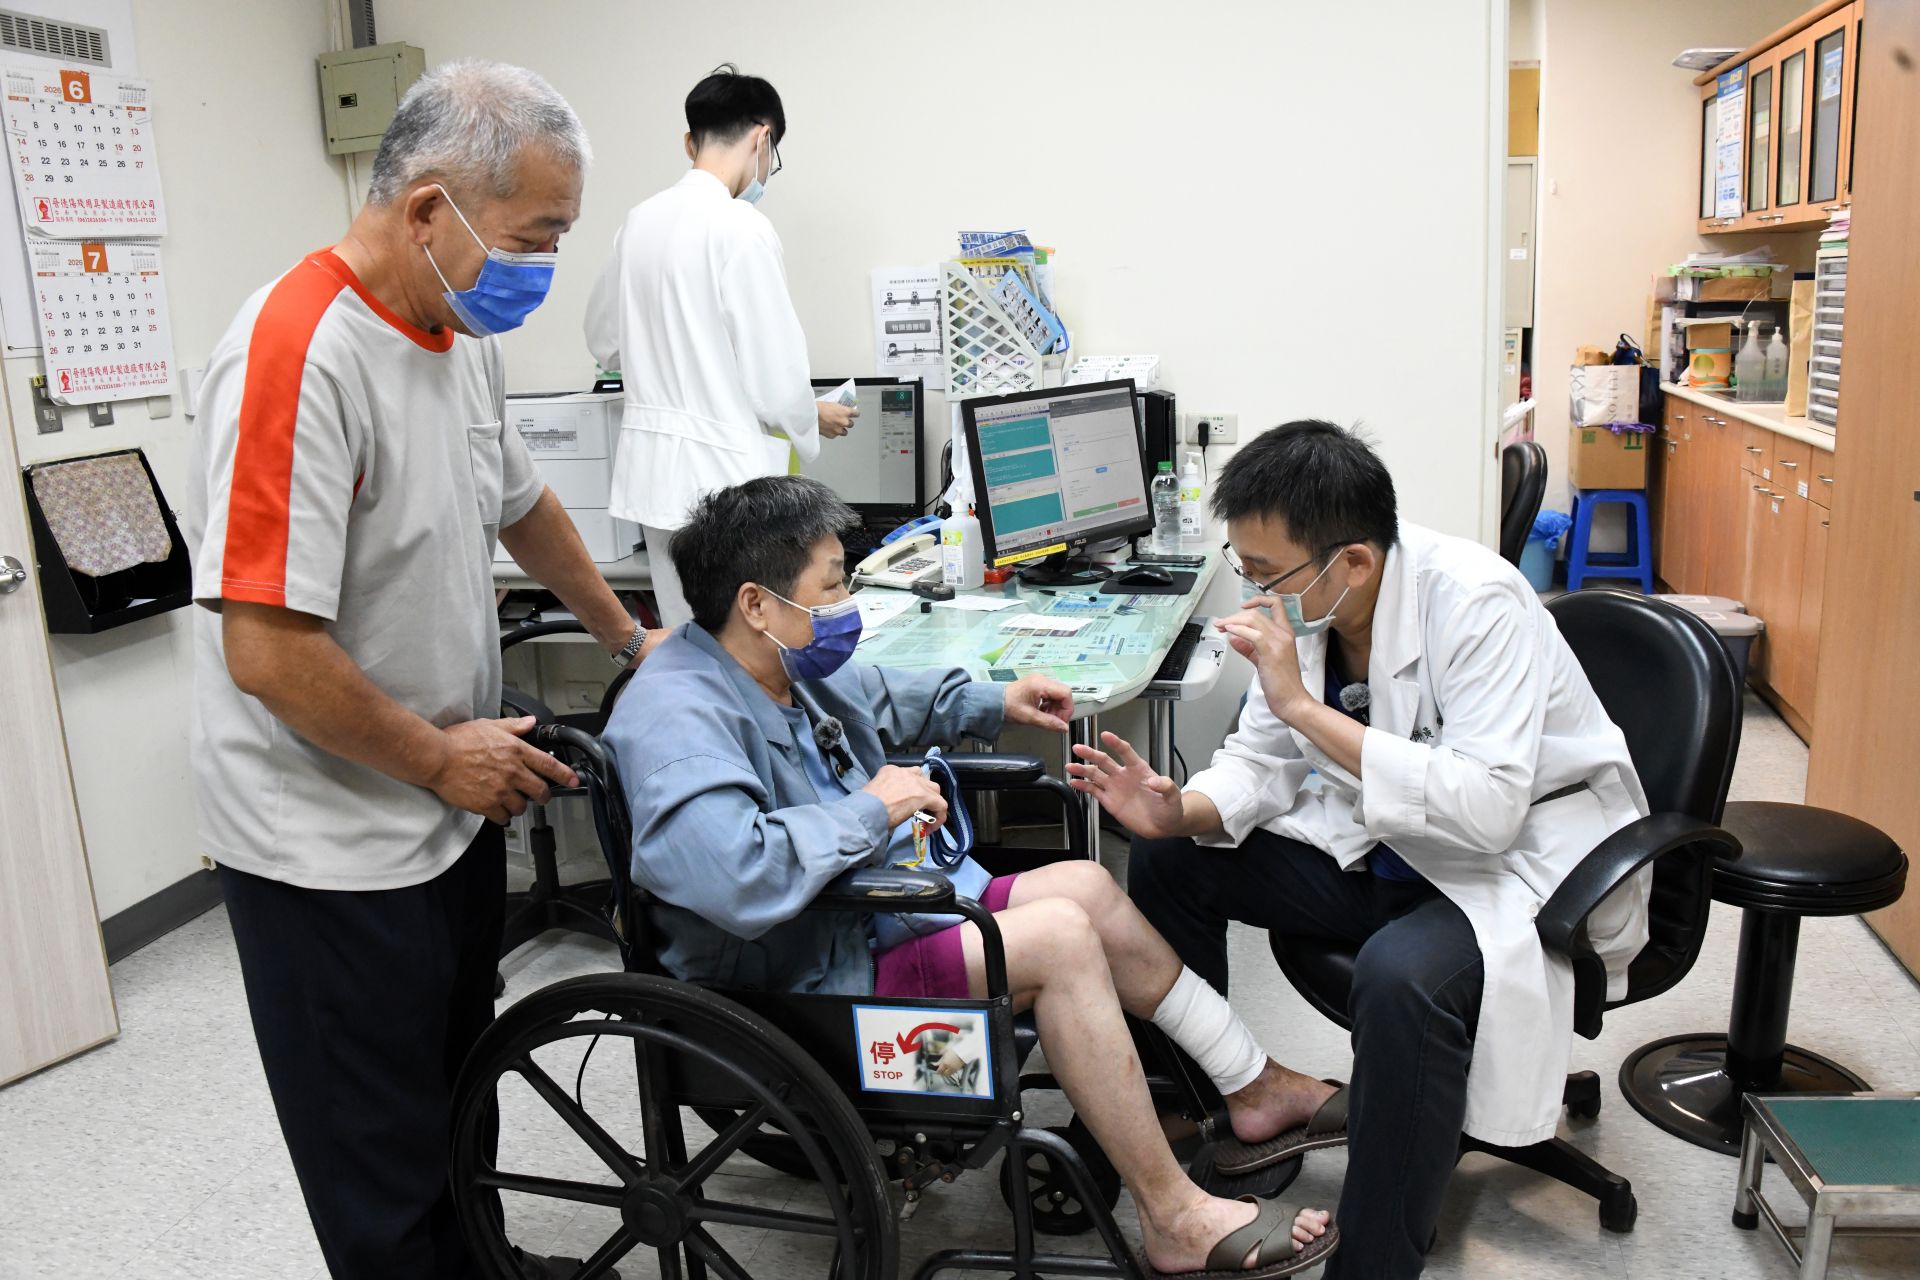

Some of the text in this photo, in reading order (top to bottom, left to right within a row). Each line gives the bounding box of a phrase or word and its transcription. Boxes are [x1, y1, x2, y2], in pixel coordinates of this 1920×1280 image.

[69, 81, 84, 99] 6
[88, 252, 100, 270] 7
[870, 1041, 895, 1065] 停
[874, 1070, 902, 1080] STOP
